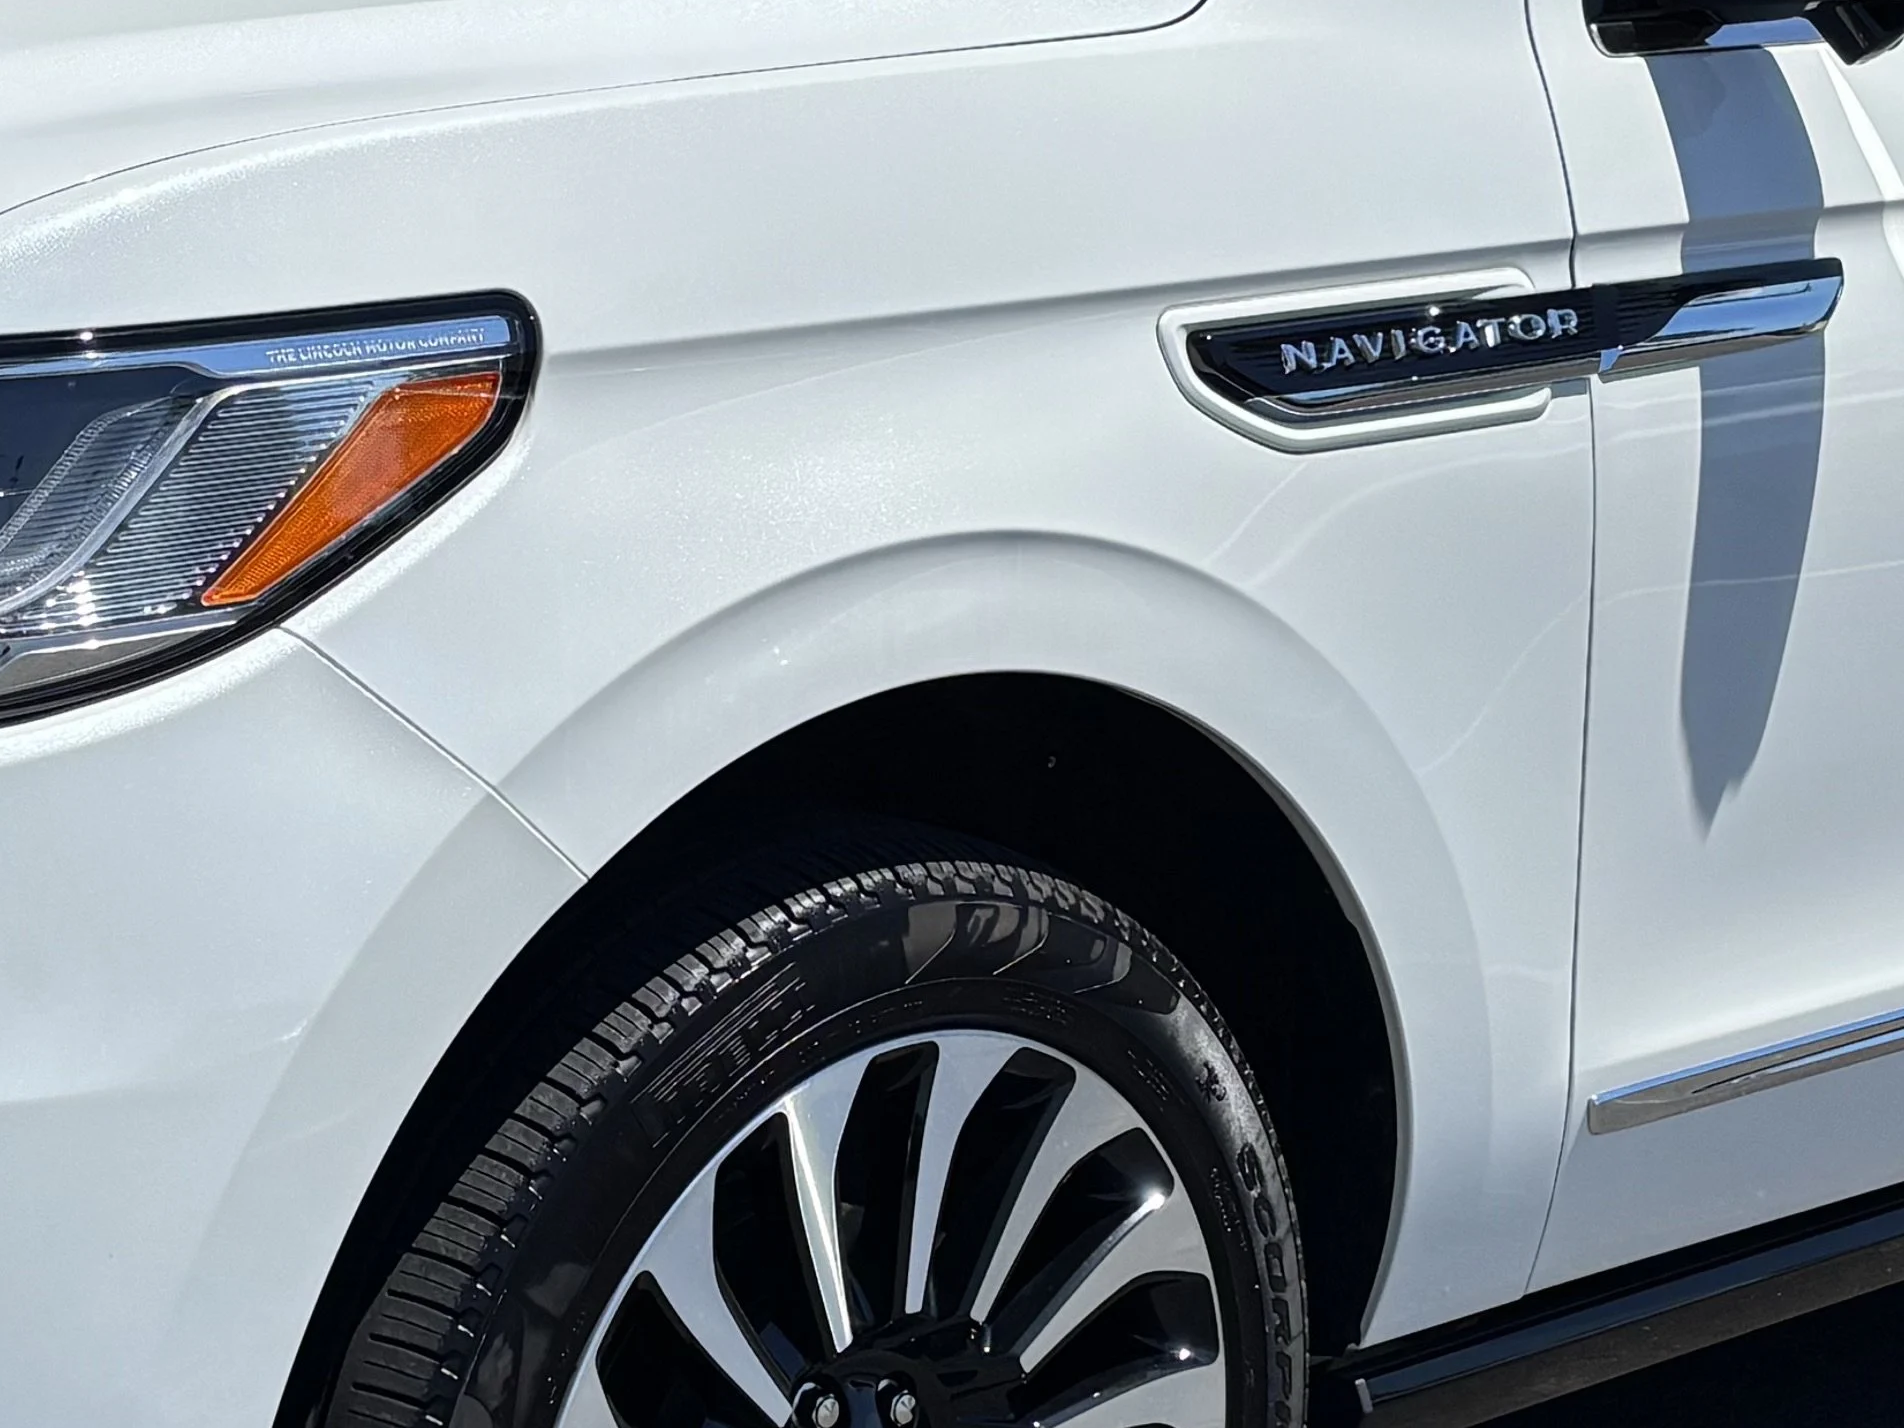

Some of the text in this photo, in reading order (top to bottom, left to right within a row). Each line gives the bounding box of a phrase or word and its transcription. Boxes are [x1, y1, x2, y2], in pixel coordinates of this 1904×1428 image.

[266, 347, 296, 363] THE
[365, 337, 416, 355] MOTOR
[1281, 308, 1578, 374] NAVIGATOR
